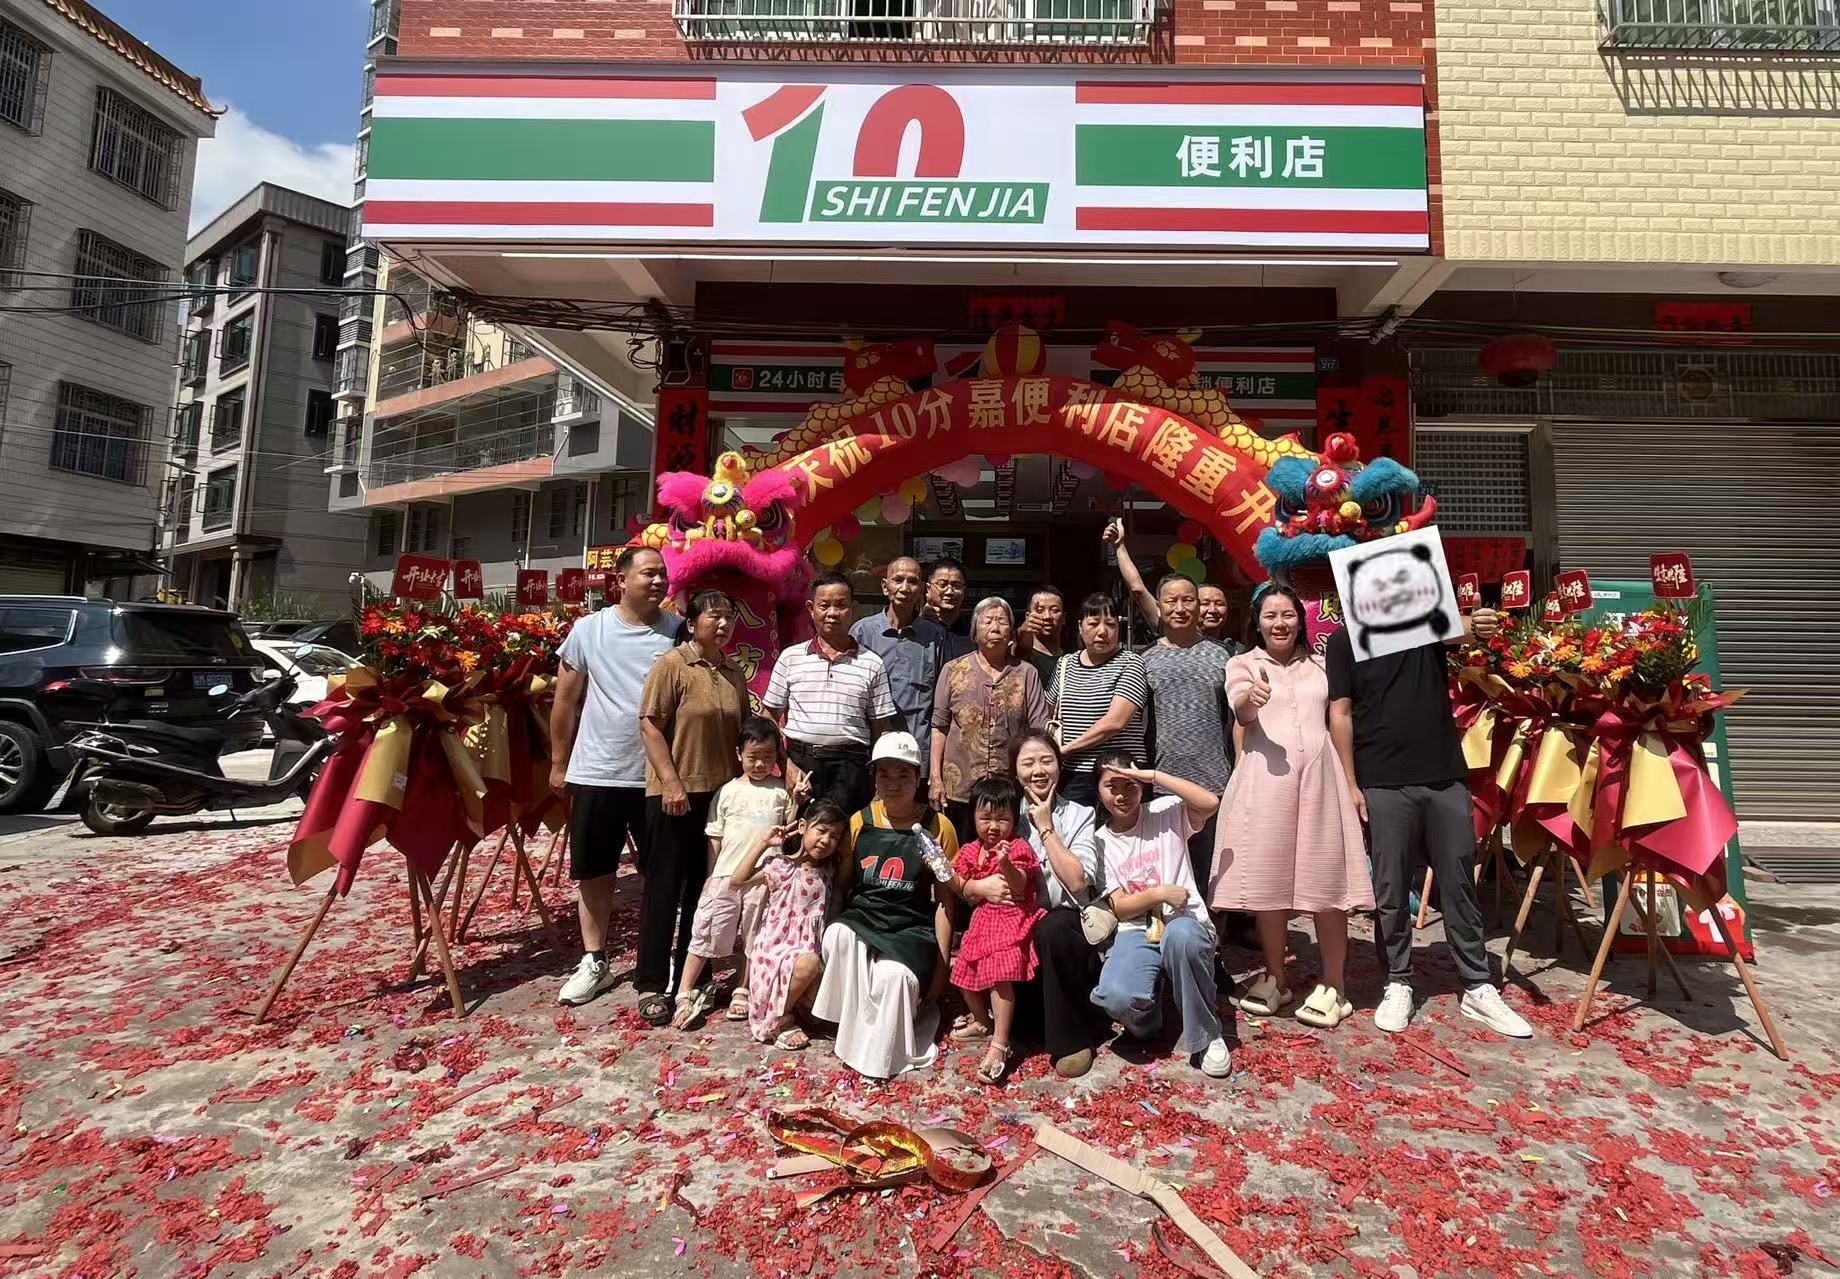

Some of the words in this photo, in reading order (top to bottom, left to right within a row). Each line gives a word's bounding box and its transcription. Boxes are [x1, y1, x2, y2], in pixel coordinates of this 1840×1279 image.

[741, 83, 965, 223] 10
[1175, 135, 1326, 178] 便利店
[821, 186, 892, 217] SHI
[896, 187, 977, 217] FEN
[977, 187, 1035, 218] JIA
